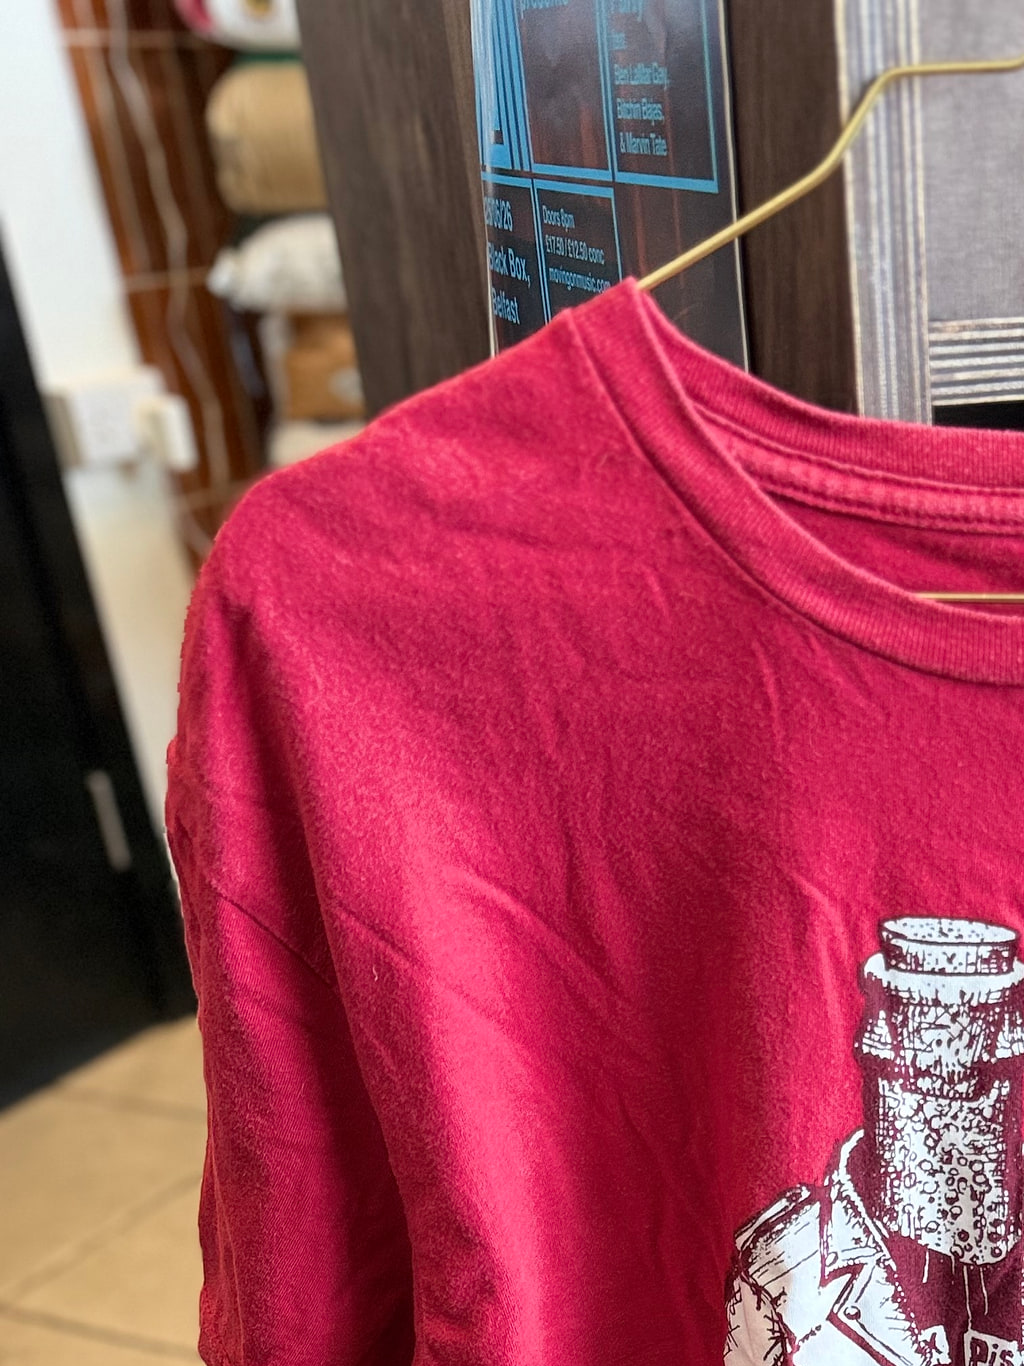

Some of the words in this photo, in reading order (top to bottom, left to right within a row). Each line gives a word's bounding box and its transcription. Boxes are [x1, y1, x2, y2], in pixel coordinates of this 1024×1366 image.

[542, 204, 561, 227] Doors
[487, 241, 509, 276] Black
[507, 247, 531, 288] Box,
[588, 247, 605, 264] conc
[491, 287, 521, 325] Belfast
